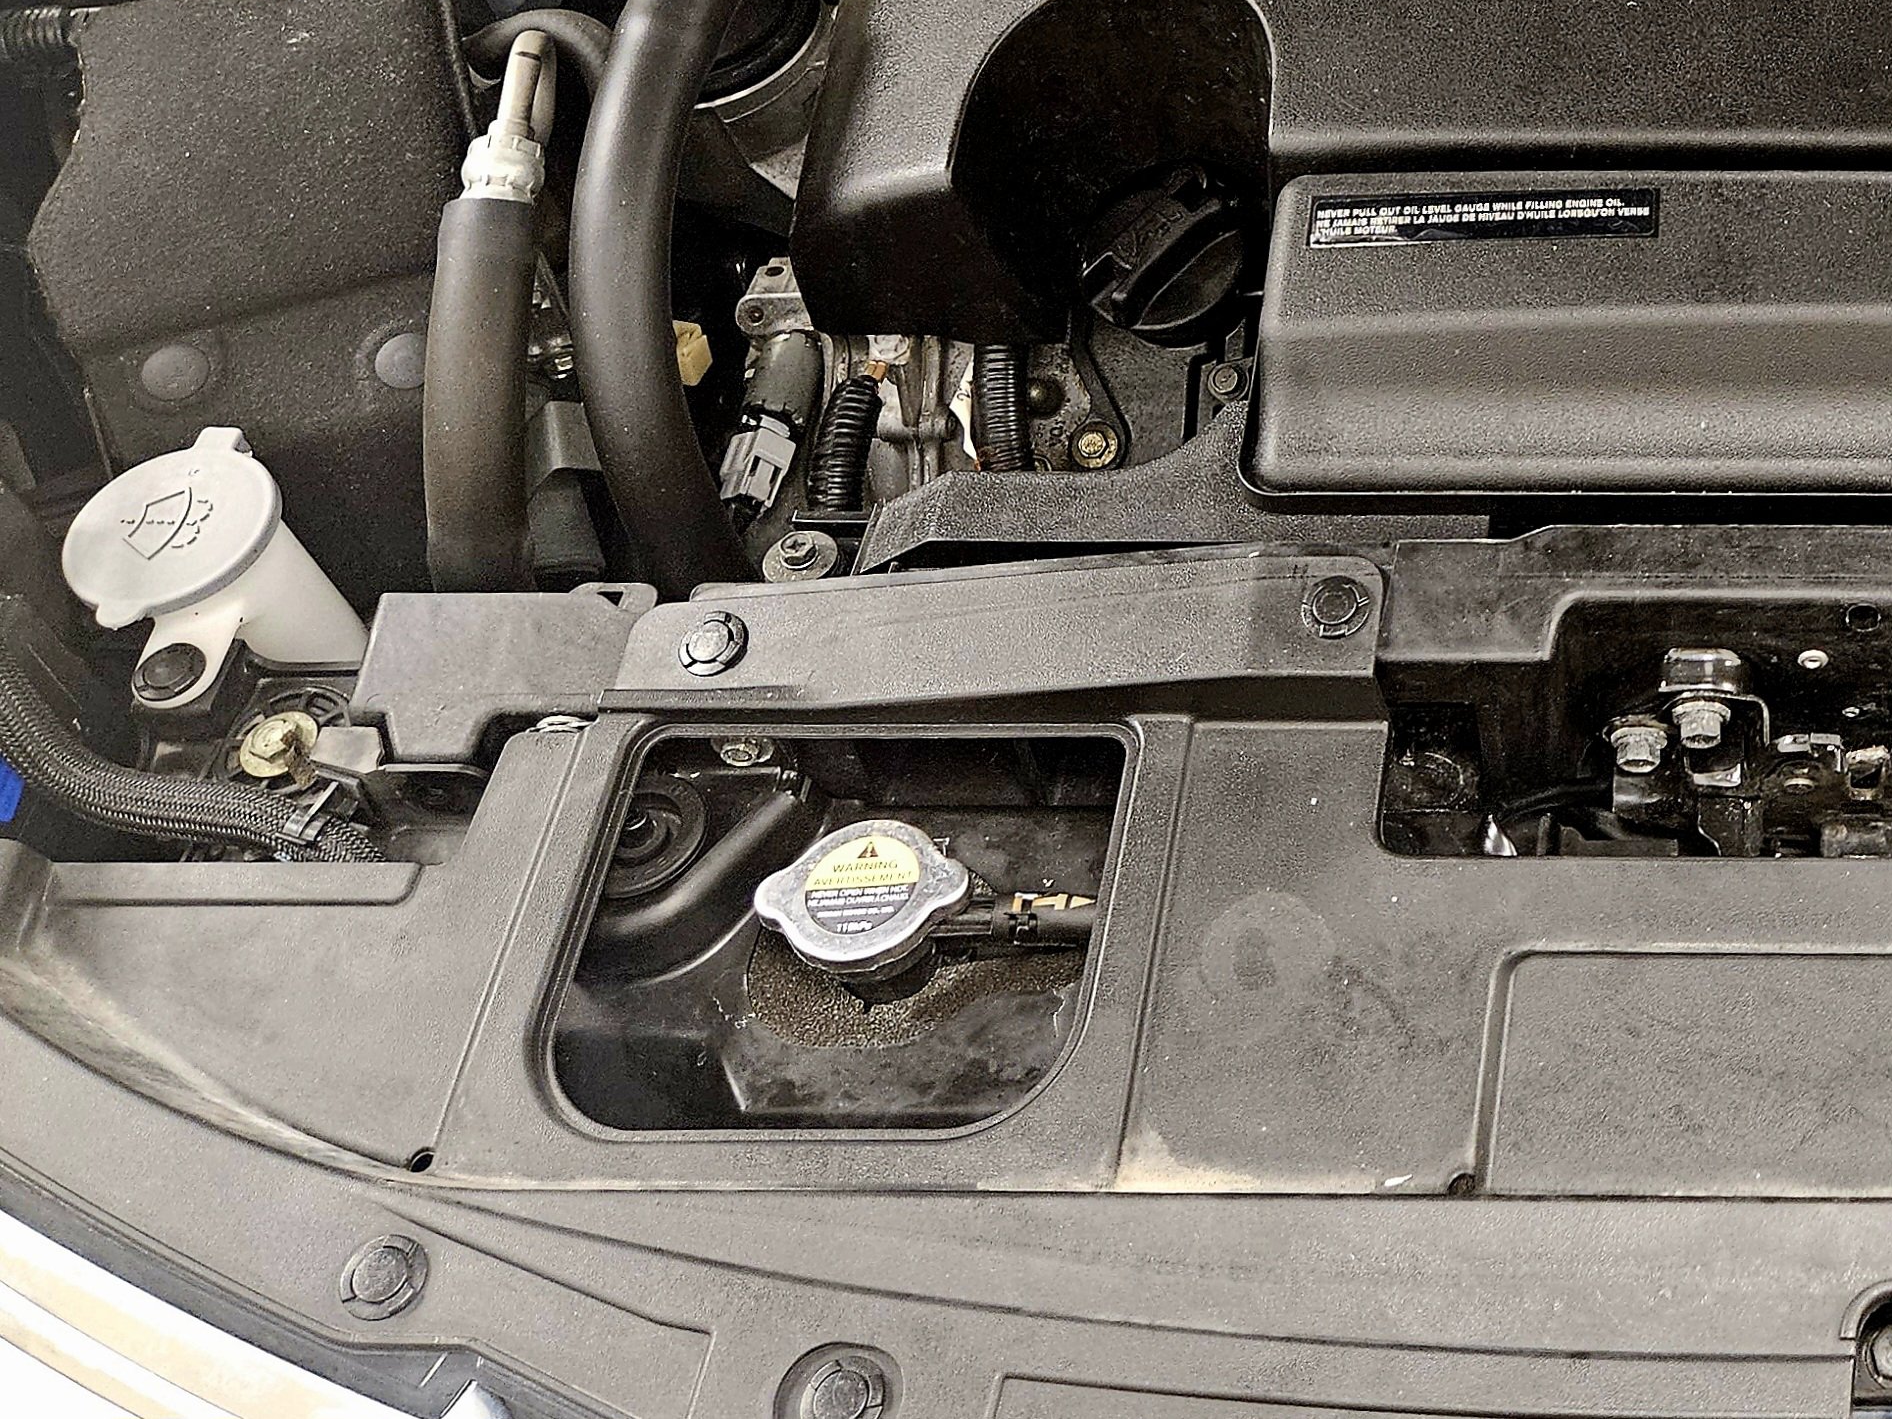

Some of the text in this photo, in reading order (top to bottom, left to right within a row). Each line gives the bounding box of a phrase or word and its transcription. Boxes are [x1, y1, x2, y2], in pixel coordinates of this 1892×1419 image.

[1317, 197, 1625, 219] NEVER PULL OUT OIL LEVEL GAUGE WHILE FILLING ENGINE OIL.
[1316, 219, 1331, 228] NE
[1332, 218, 1368, 228] JAMAIS
[1370, 216, 1411, 226] RETIRER
[1413, 215, 1425, 224] LA
[1427, 214, 1459, 224] JAUGE
[1462, 212, 1476, 222] DE
[1478, 211, 1514, 222] NIVEAU
[1517, 209, 1556, 220] D'HUILE
[1618, 207, 1650, 217] VERSE
[833, 860, 898, 873] WARNING
[814, 871, 912, 885] AVERTISSEMENT
